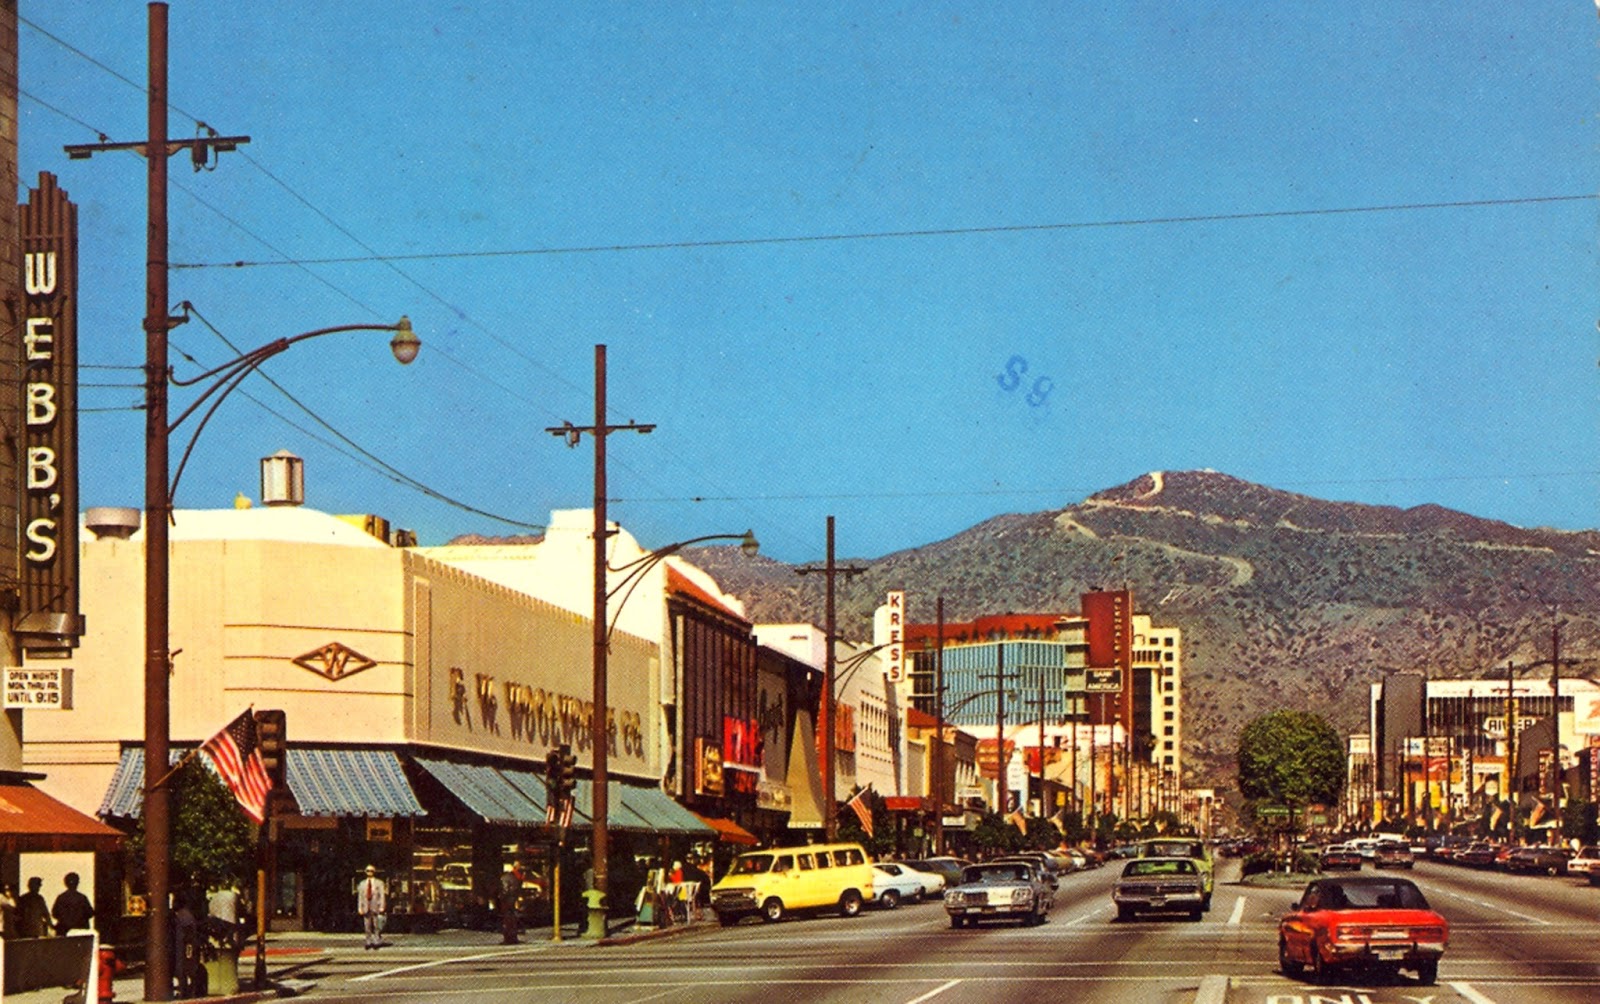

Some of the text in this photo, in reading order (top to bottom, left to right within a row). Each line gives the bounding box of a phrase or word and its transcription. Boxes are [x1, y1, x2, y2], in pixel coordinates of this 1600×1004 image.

[24, 251, 60, 562] WEBB'S
[890, 595, 900, 679] KRESS
[8, 692, 32, 703] UNTIL
[9, 672, 28, 680] OPEN
[503, 681, 617, 757] WOOLWORH
